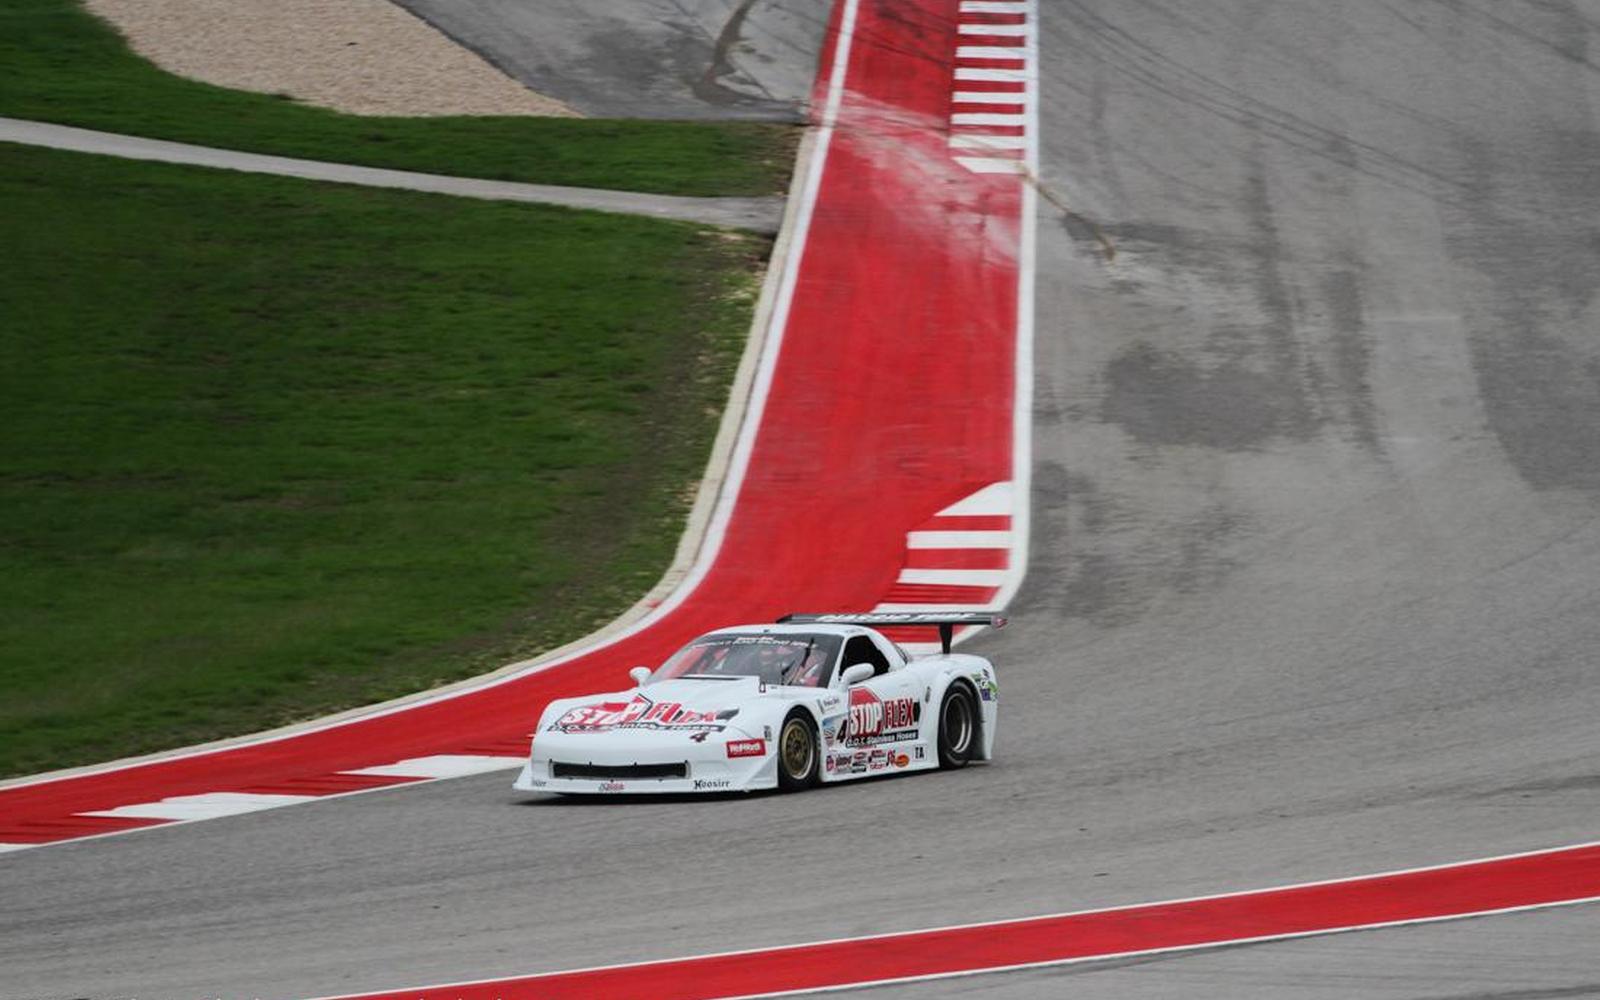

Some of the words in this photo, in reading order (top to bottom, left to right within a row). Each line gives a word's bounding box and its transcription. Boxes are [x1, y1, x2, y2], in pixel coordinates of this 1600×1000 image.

[850, 702, 882, 735] STOP
[884, 698, 913, 728] FLEX
[690, 732, 709, 743] 4
[836, 719, 848, 743] 4
[915, 747, 924, 759] TA
